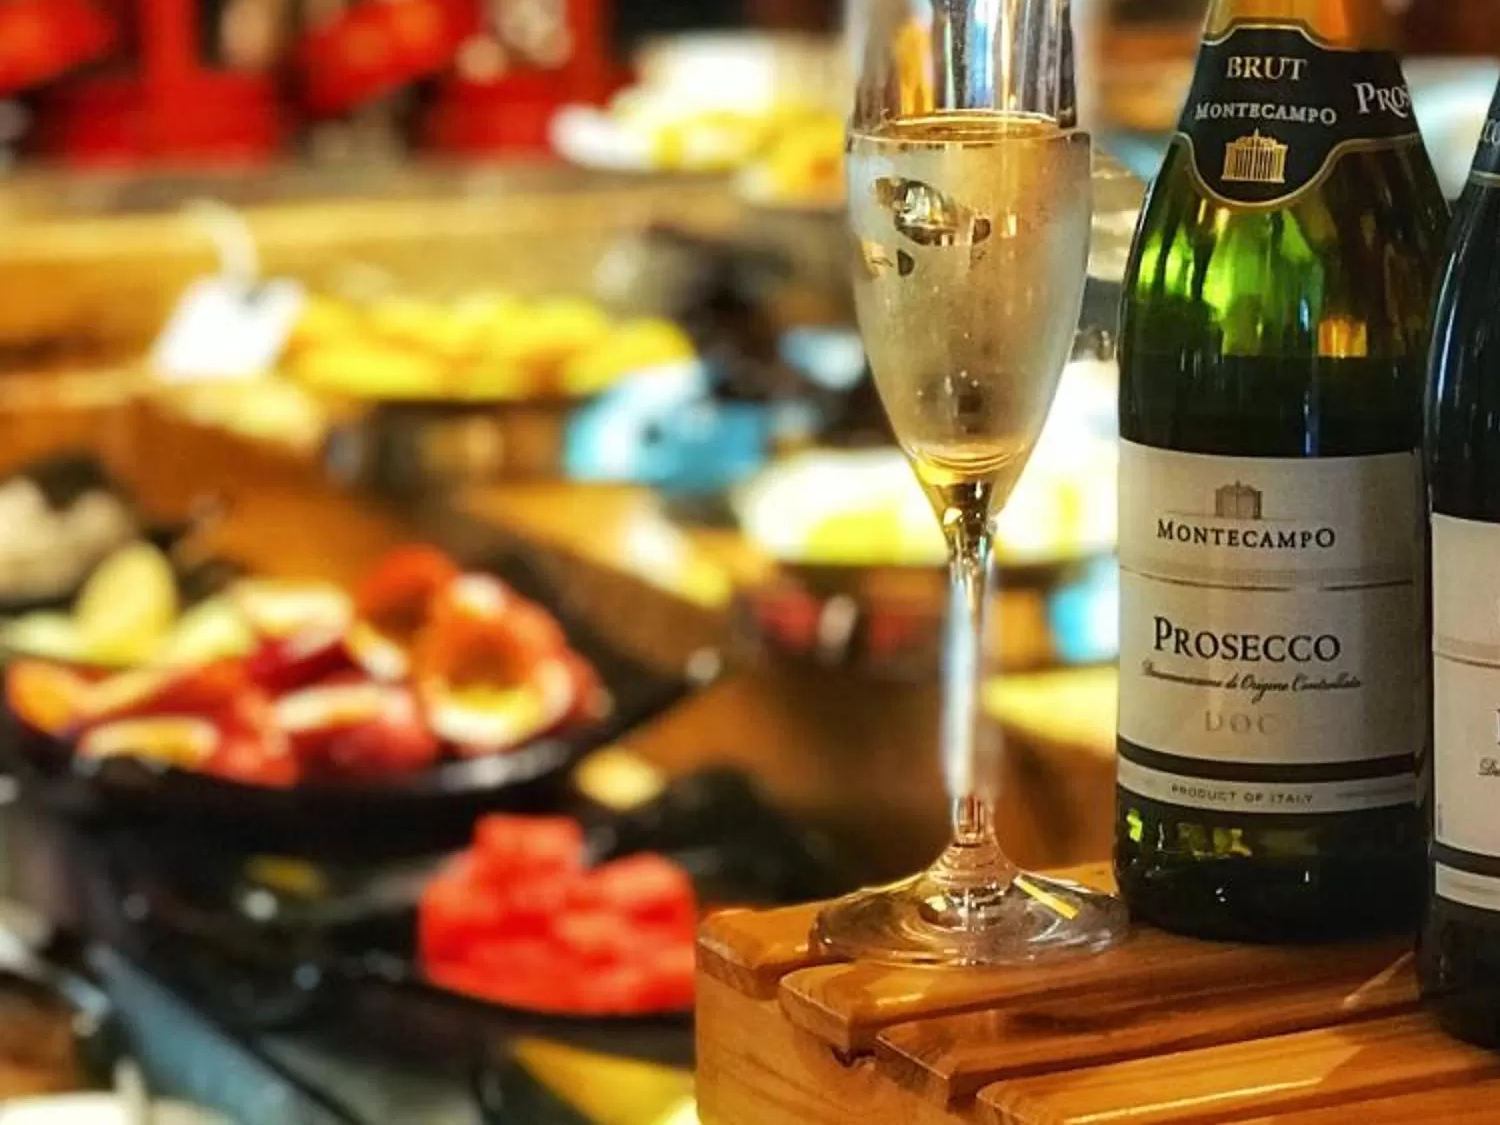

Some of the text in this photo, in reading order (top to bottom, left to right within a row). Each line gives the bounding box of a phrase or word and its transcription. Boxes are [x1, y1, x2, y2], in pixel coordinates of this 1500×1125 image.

[1227, 56, 1307, 80] BRUT
[1195, 102, 1337, 125] MONTECAMPO
[1157, 518, 1336, 549] MONTECAMPO
[1154, 615, 1341, 662] PROSECCO
[1171, 783, 1313, 804] PRODUCT OF ITALY
